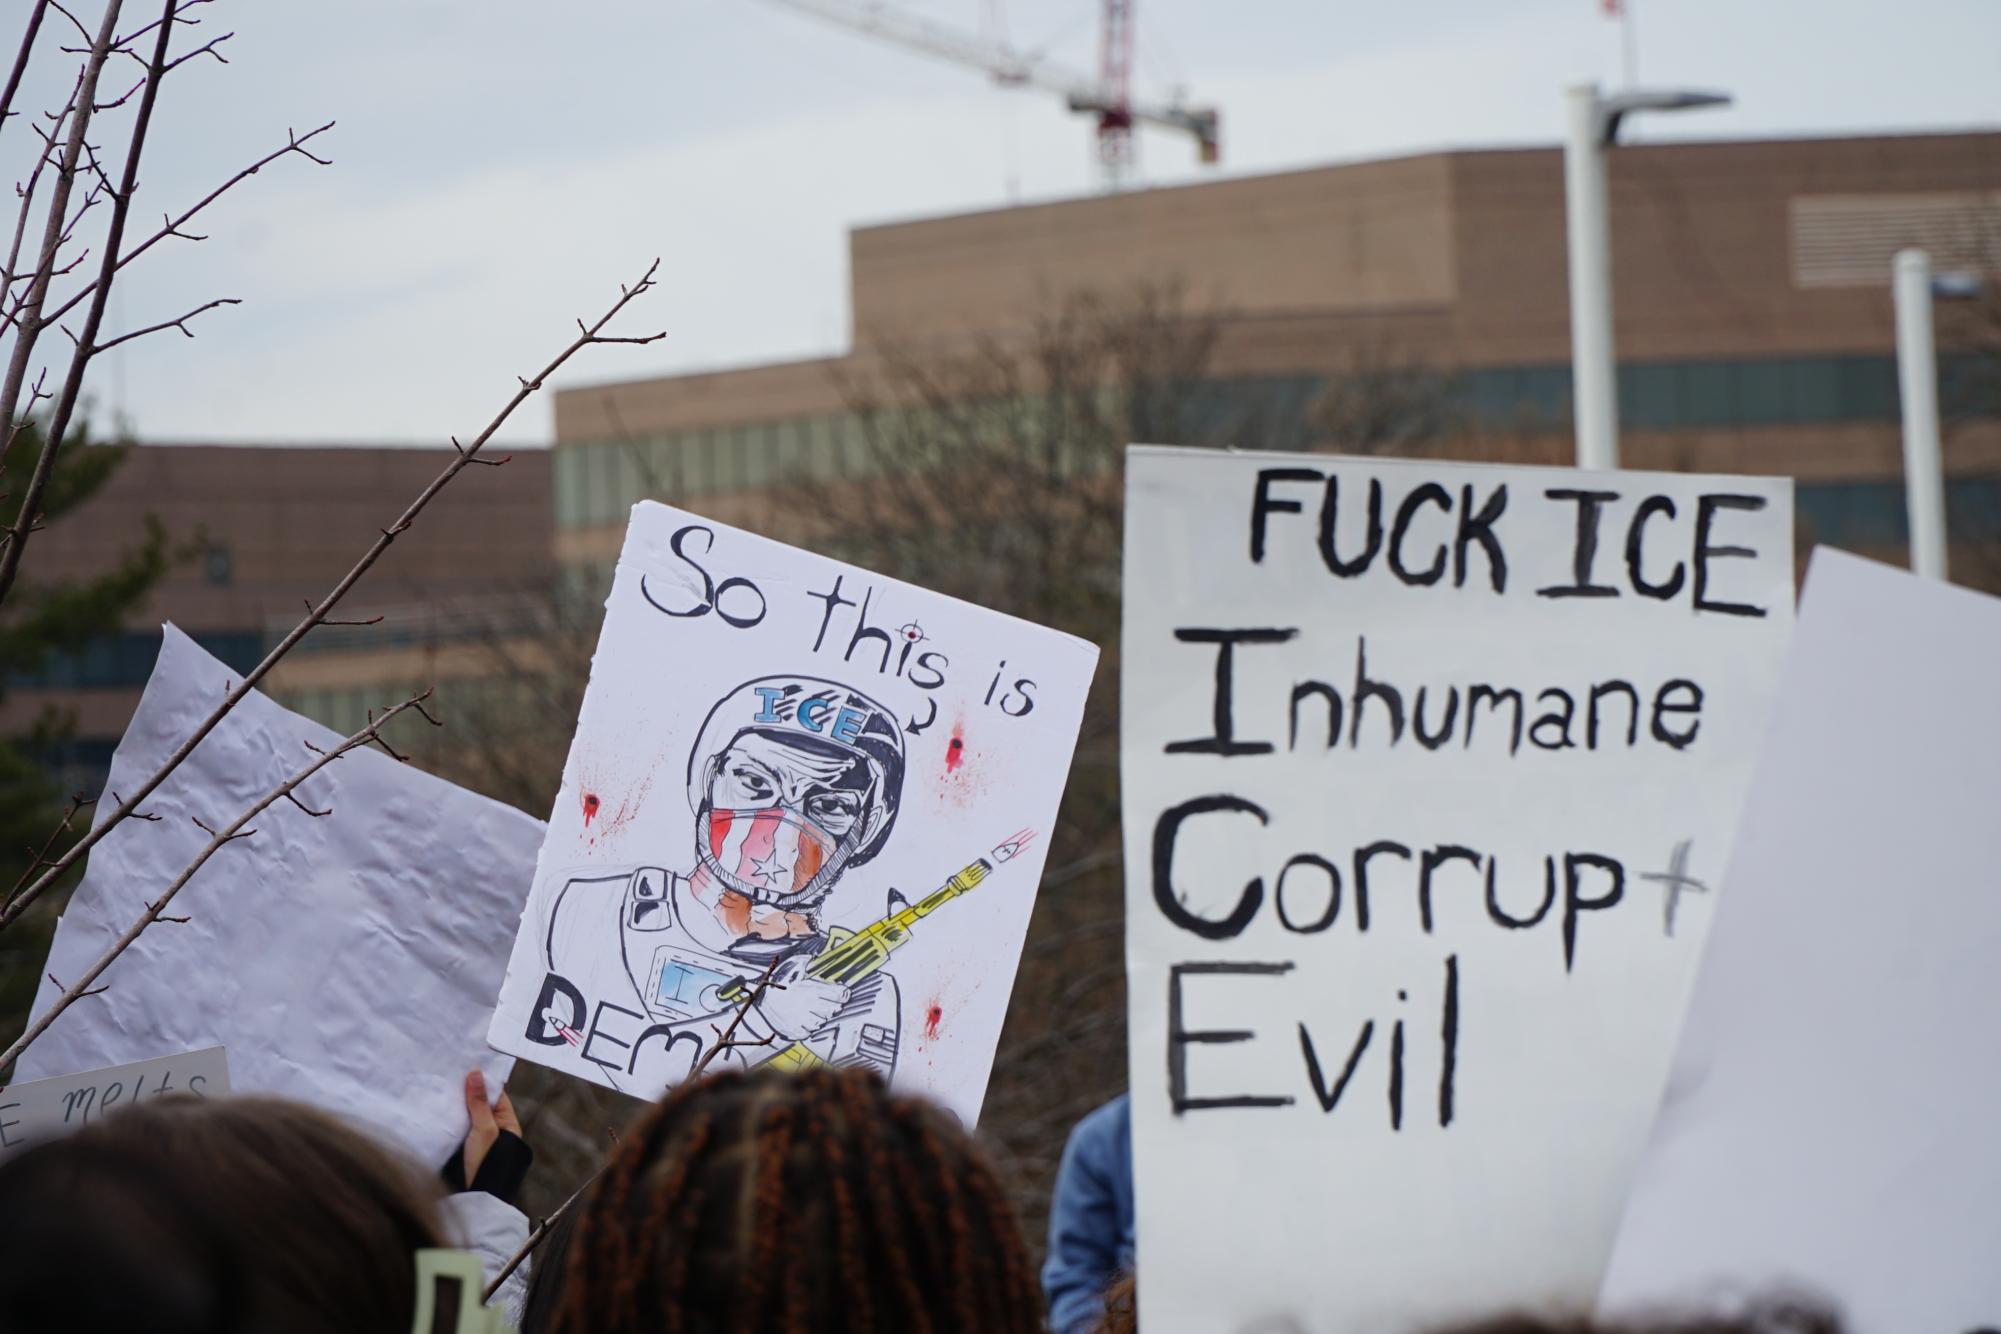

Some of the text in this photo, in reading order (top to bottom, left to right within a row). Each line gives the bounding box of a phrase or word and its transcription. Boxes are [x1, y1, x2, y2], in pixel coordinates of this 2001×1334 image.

[641, 525, 1038, 718] So this is
[1249, 469, 1768, 618] FUCK ICE
[754, 687, 869, 747] ICE
[1163, 627, 1705, 758] Inhumane
[1152, 794, 1710, 975] Corrupt
[1166, 953, 1459, 1132] Evil
